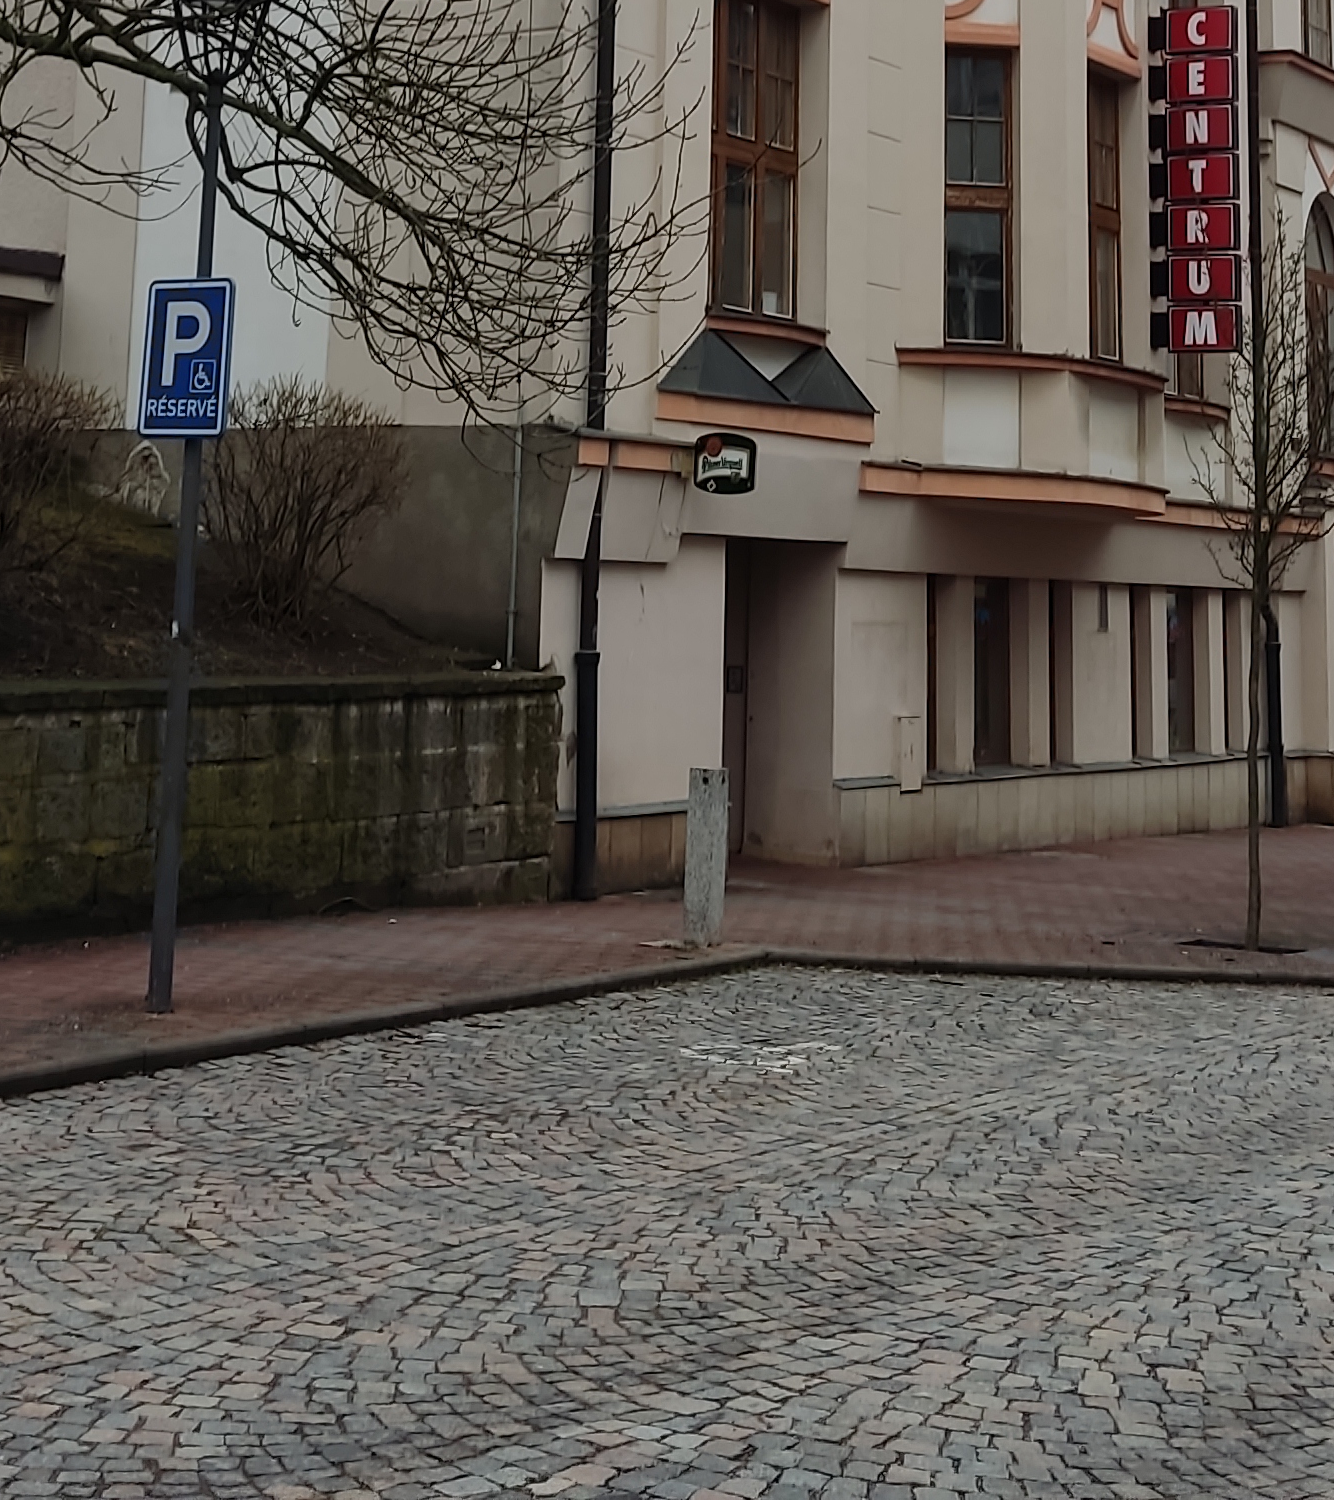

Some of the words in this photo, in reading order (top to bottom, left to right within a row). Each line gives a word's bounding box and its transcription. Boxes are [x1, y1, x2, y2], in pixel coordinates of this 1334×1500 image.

[1184, 11, 1218, 347] CENTRUM
[161, 302, 211, 387] P
[147, 396, 217, 417] RÉSERVÉ
